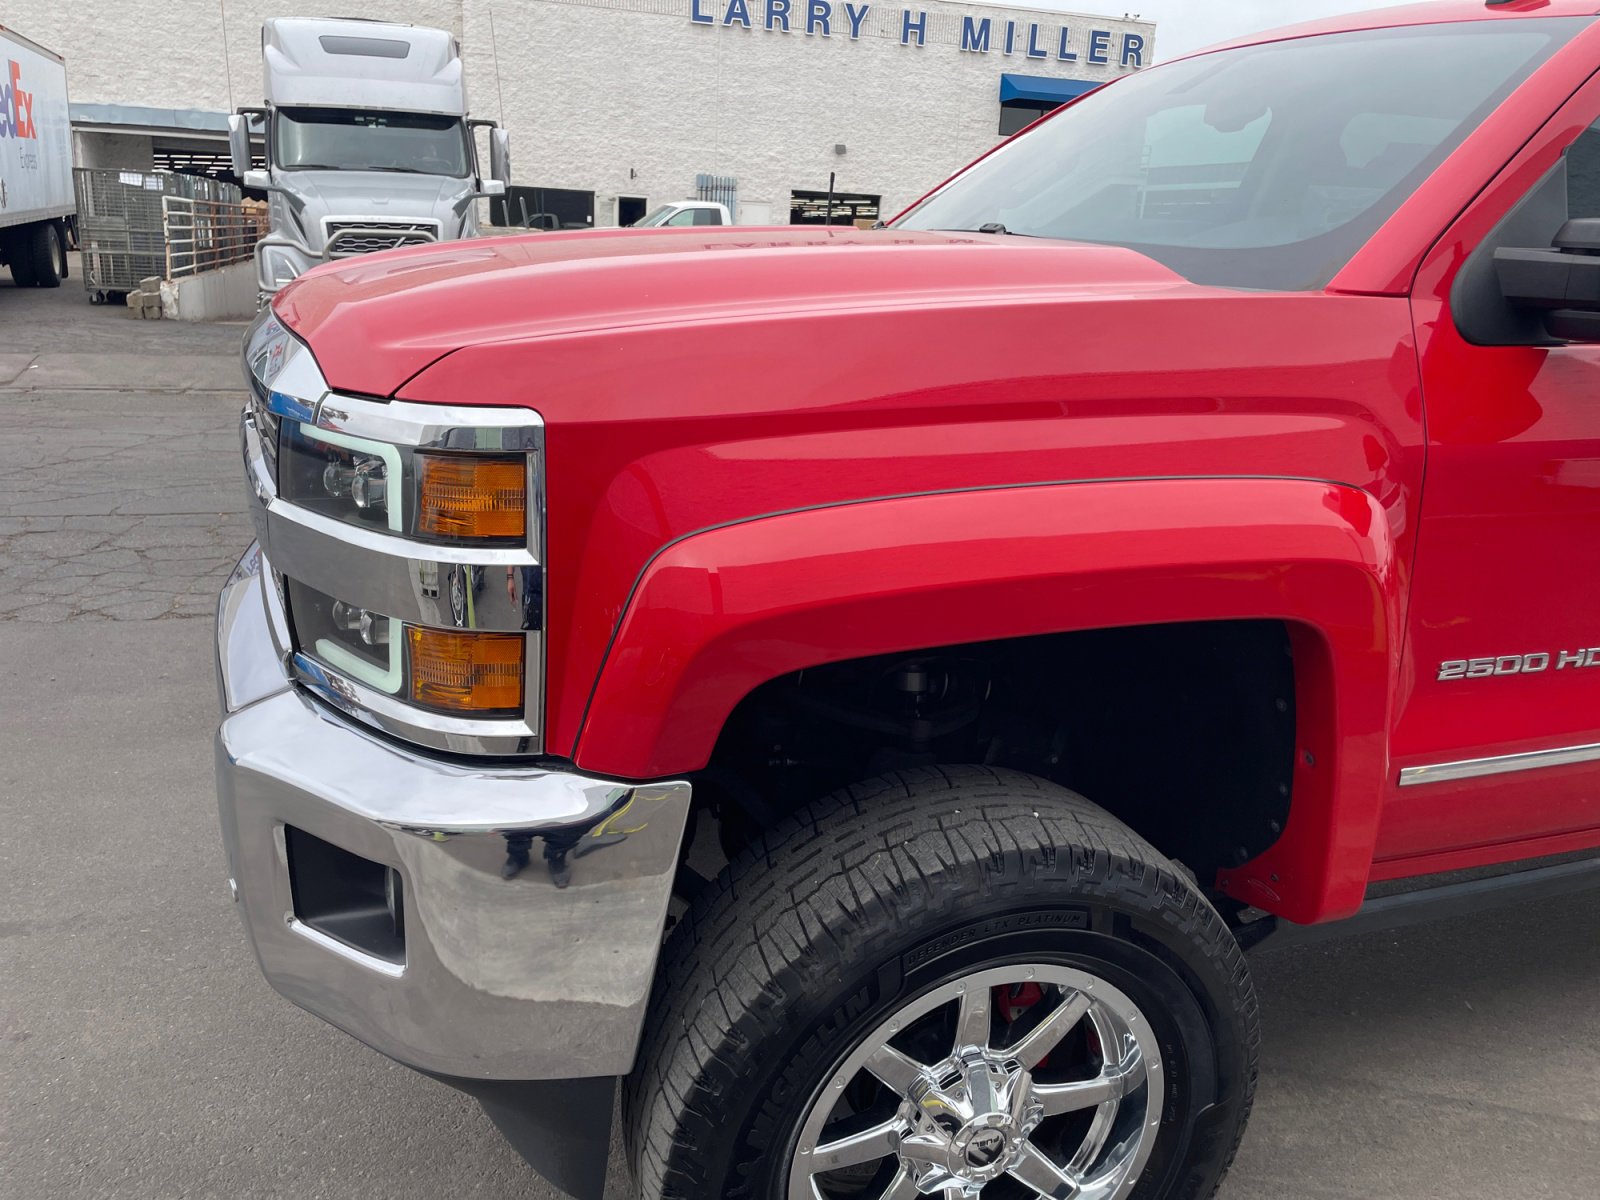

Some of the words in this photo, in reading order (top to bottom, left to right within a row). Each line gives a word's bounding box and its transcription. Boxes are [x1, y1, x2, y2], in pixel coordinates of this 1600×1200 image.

[690, 0, 869, 40] LARRY
[901, 9, 927, 46] H
[960, 15, 1144, 67] MILLER
[1437, 652, 1549, 681] 2500
[1555, 647, 1600, 670] HD
[907, 928, 978, 966] DEFENDER
[984, 919, 1011, 933] LTX
[1016, 913, 1083, 927] PLATINUM
[745, 985, 871, 1150] MICHELIN
[971, 1135, 1000, 1147] FUEL
